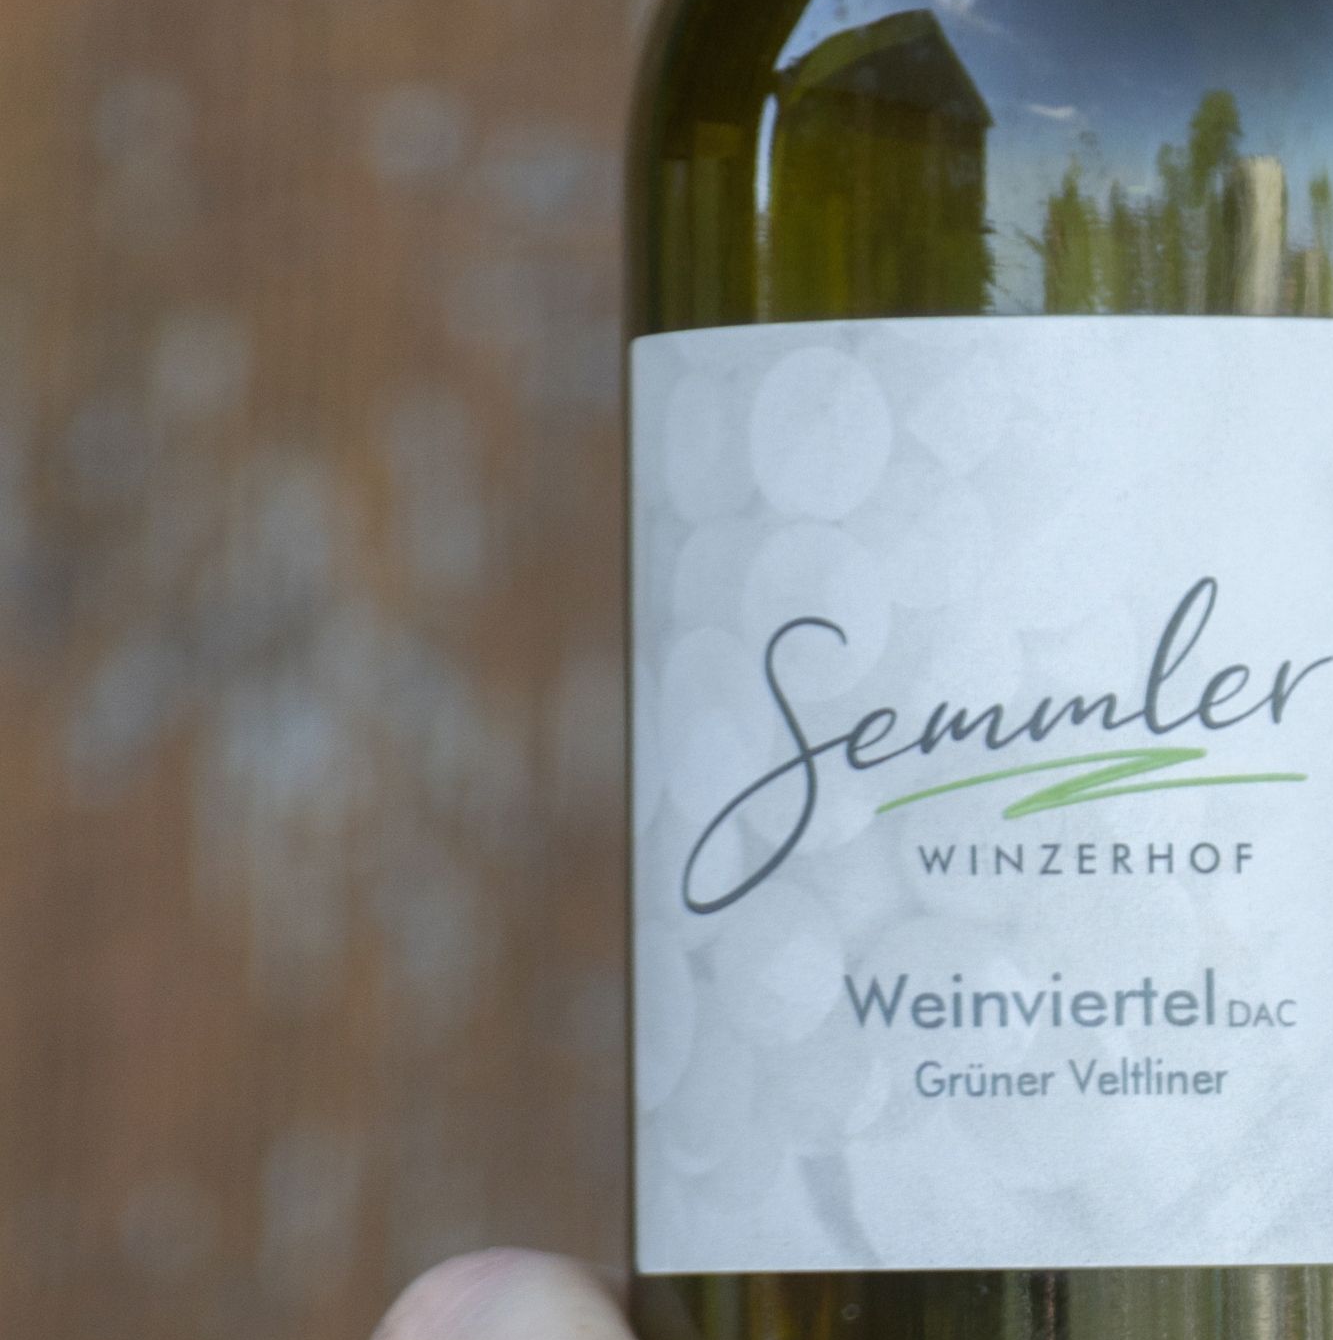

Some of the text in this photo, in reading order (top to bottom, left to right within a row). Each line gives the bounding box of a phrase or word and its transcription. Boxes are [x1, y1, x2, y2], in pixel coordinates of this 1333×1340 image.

[918, 842, 1255, 876] WINZERHOF
[844, 967, 1299, 1031] Weinviertel DAC
[914, 1057, 1229, 1099] Grüner Veltliner
